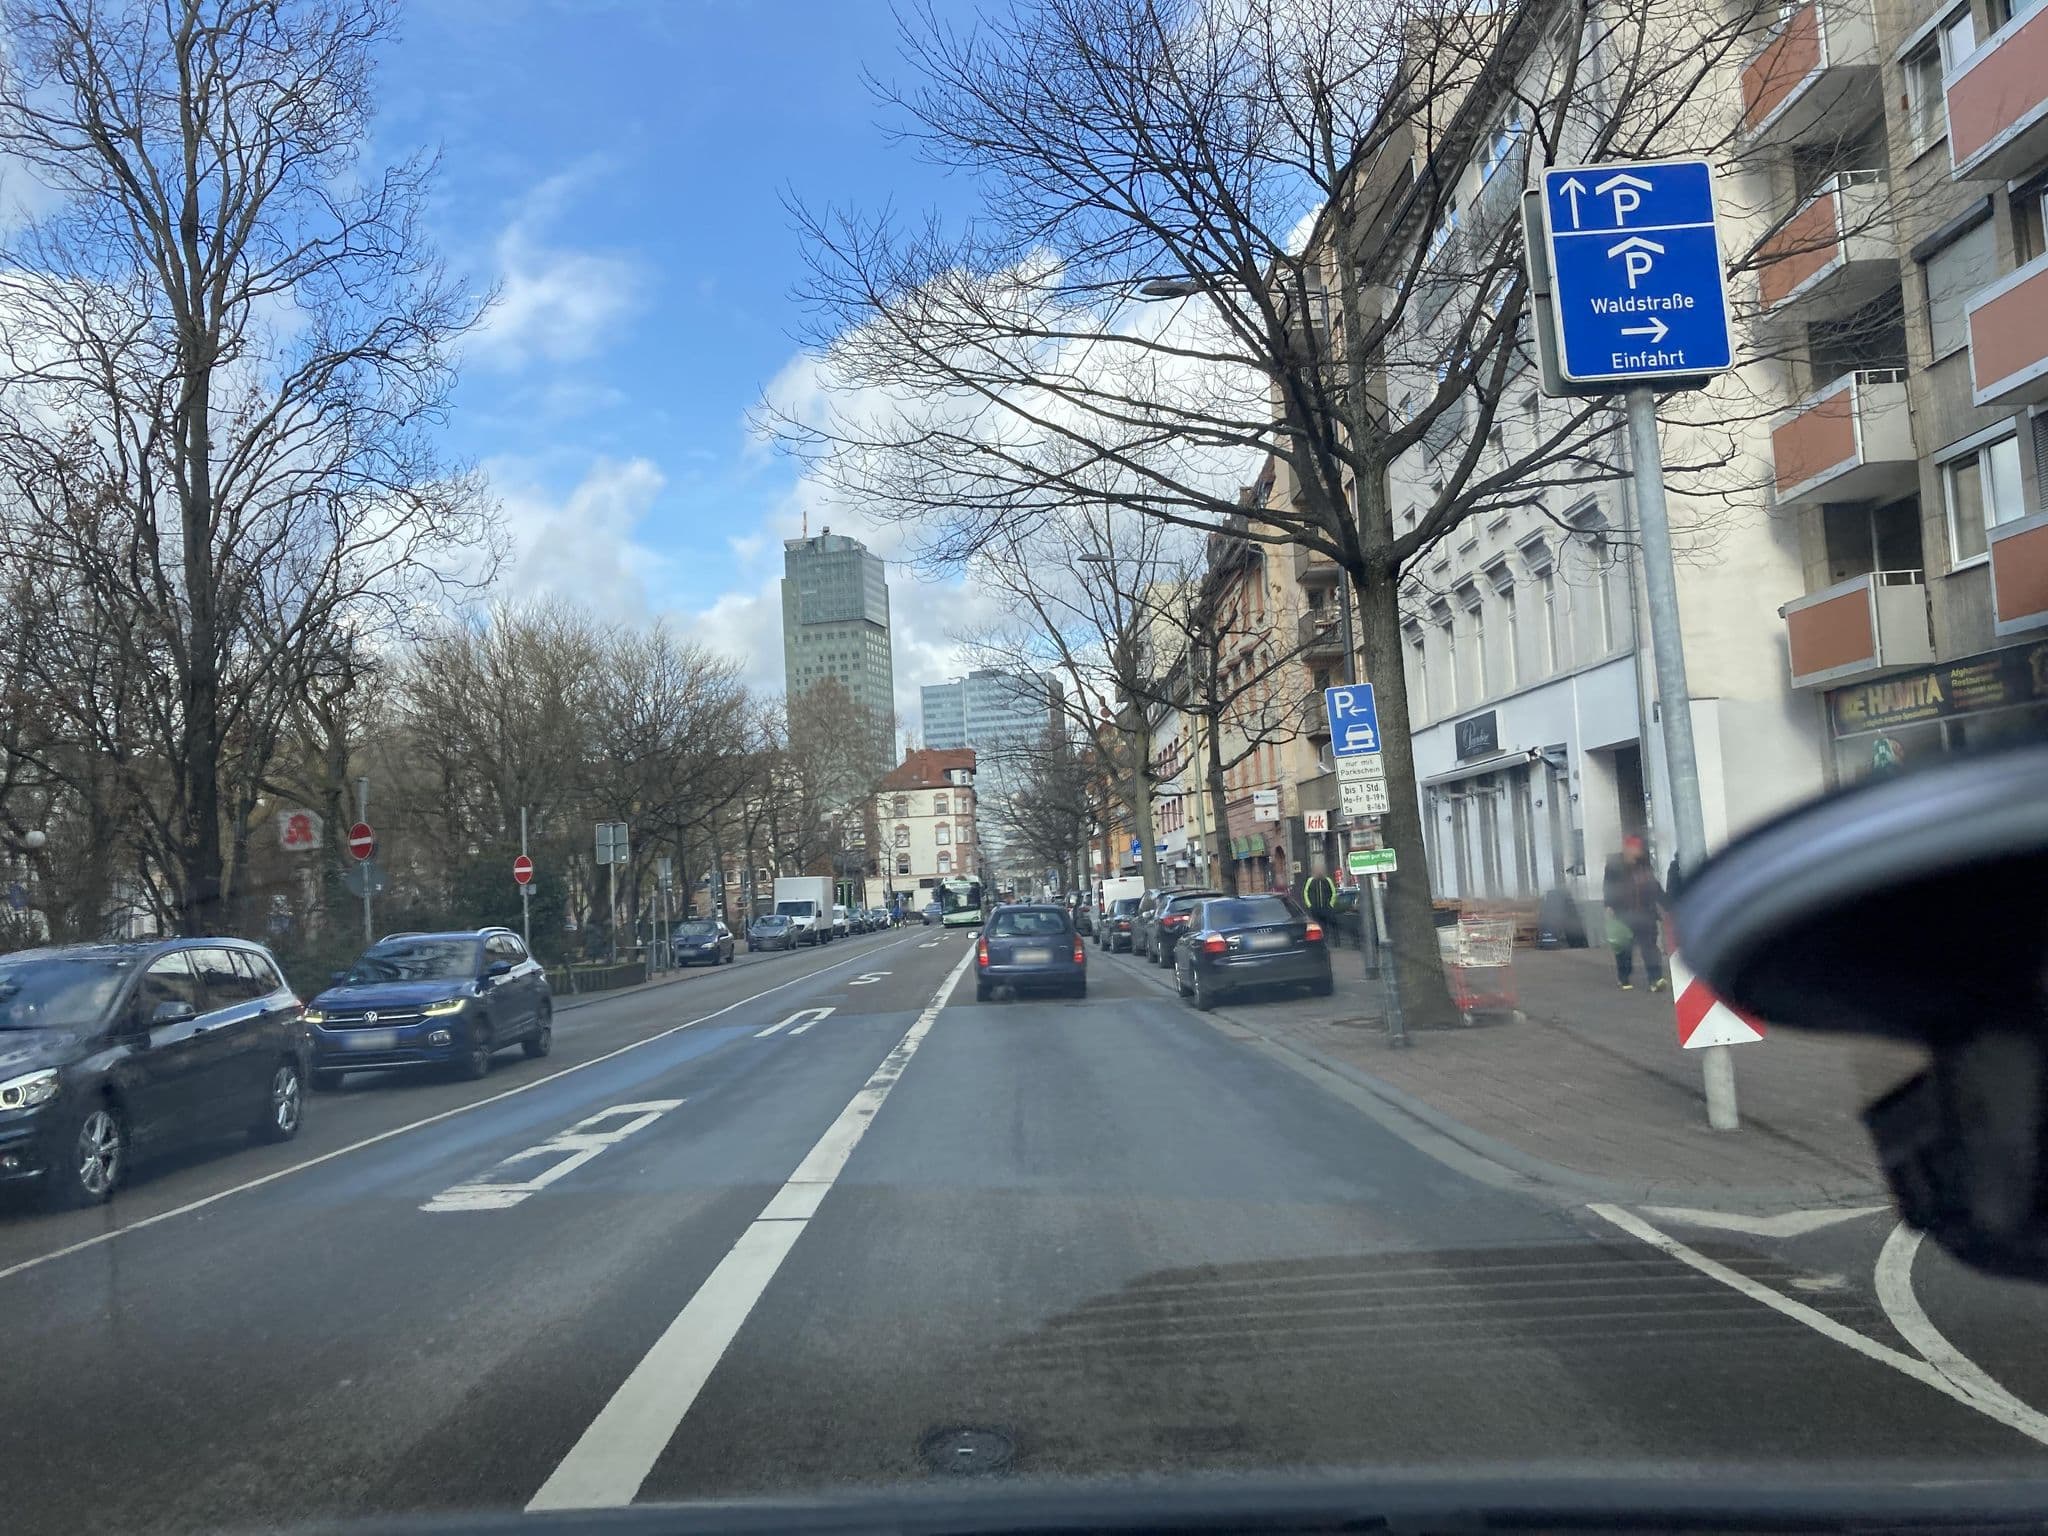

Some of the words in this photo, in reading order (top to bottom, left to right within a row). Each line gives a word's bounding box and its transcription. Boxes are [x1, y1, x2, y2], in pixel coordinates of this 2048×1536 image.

[1612, 188, 1640, 226] P
[1625, 251, 1653, 289] P
[1590, 293, 1695, 314] Waldstraße
[1611, 349, 1686, 369] Einfahrt
[1333, 691, 1354, 719] P
[1340, 768, 1380, 776] Parkschein
[1344, 785, 1356, 795] bis
[1359, 784, 1363, 793] 1
